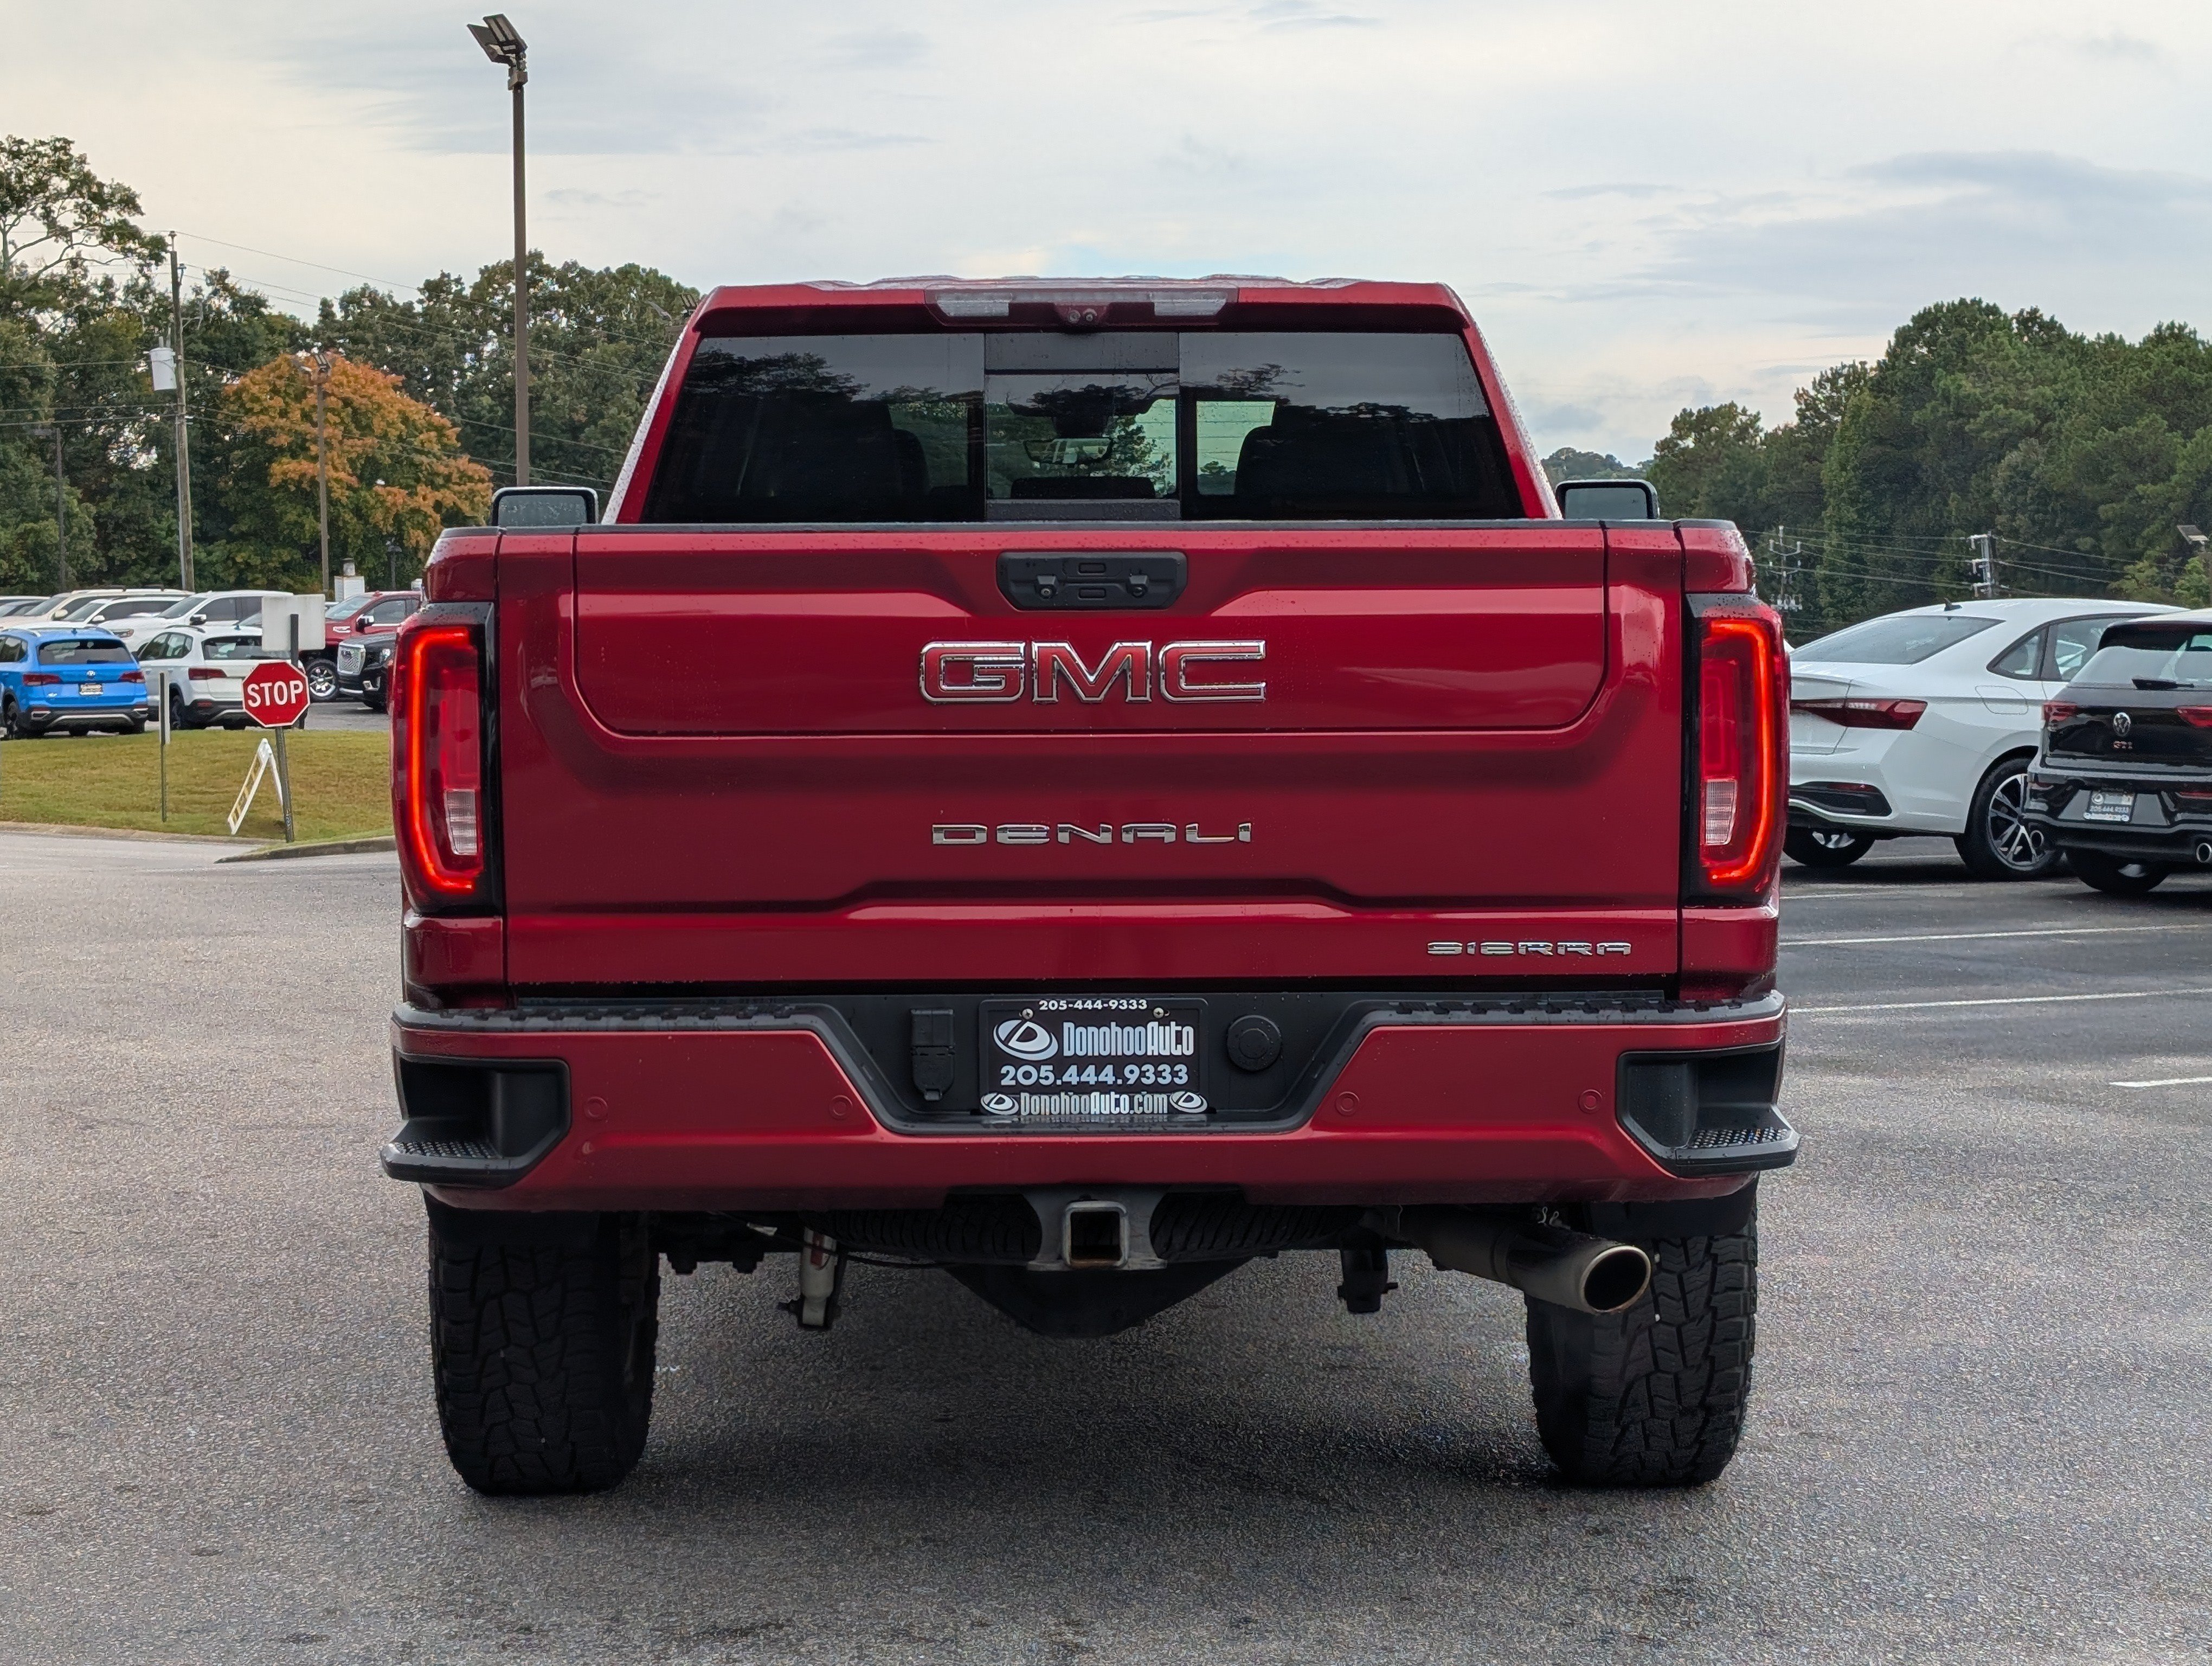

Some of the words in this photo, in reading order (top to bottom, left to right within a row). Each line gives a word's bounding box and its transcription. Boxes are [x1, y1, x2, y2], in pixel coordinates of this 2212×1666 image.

[919, 640, 1266, 703] GMC
[247, 680, 303, 707] STOP
[932, 823, 1252, 844] DENALI
[1427, 941, 1632, 956] SIERRA
[1039, 999, 1148, 1010] 205-444-9333
[1063, 1021, 1194, 1056] DonohooAuto
[1000, 1064, 1188, 1086] 205.444.9333
[1020, 1091, 1168, 1116] DonohooAuto.com
